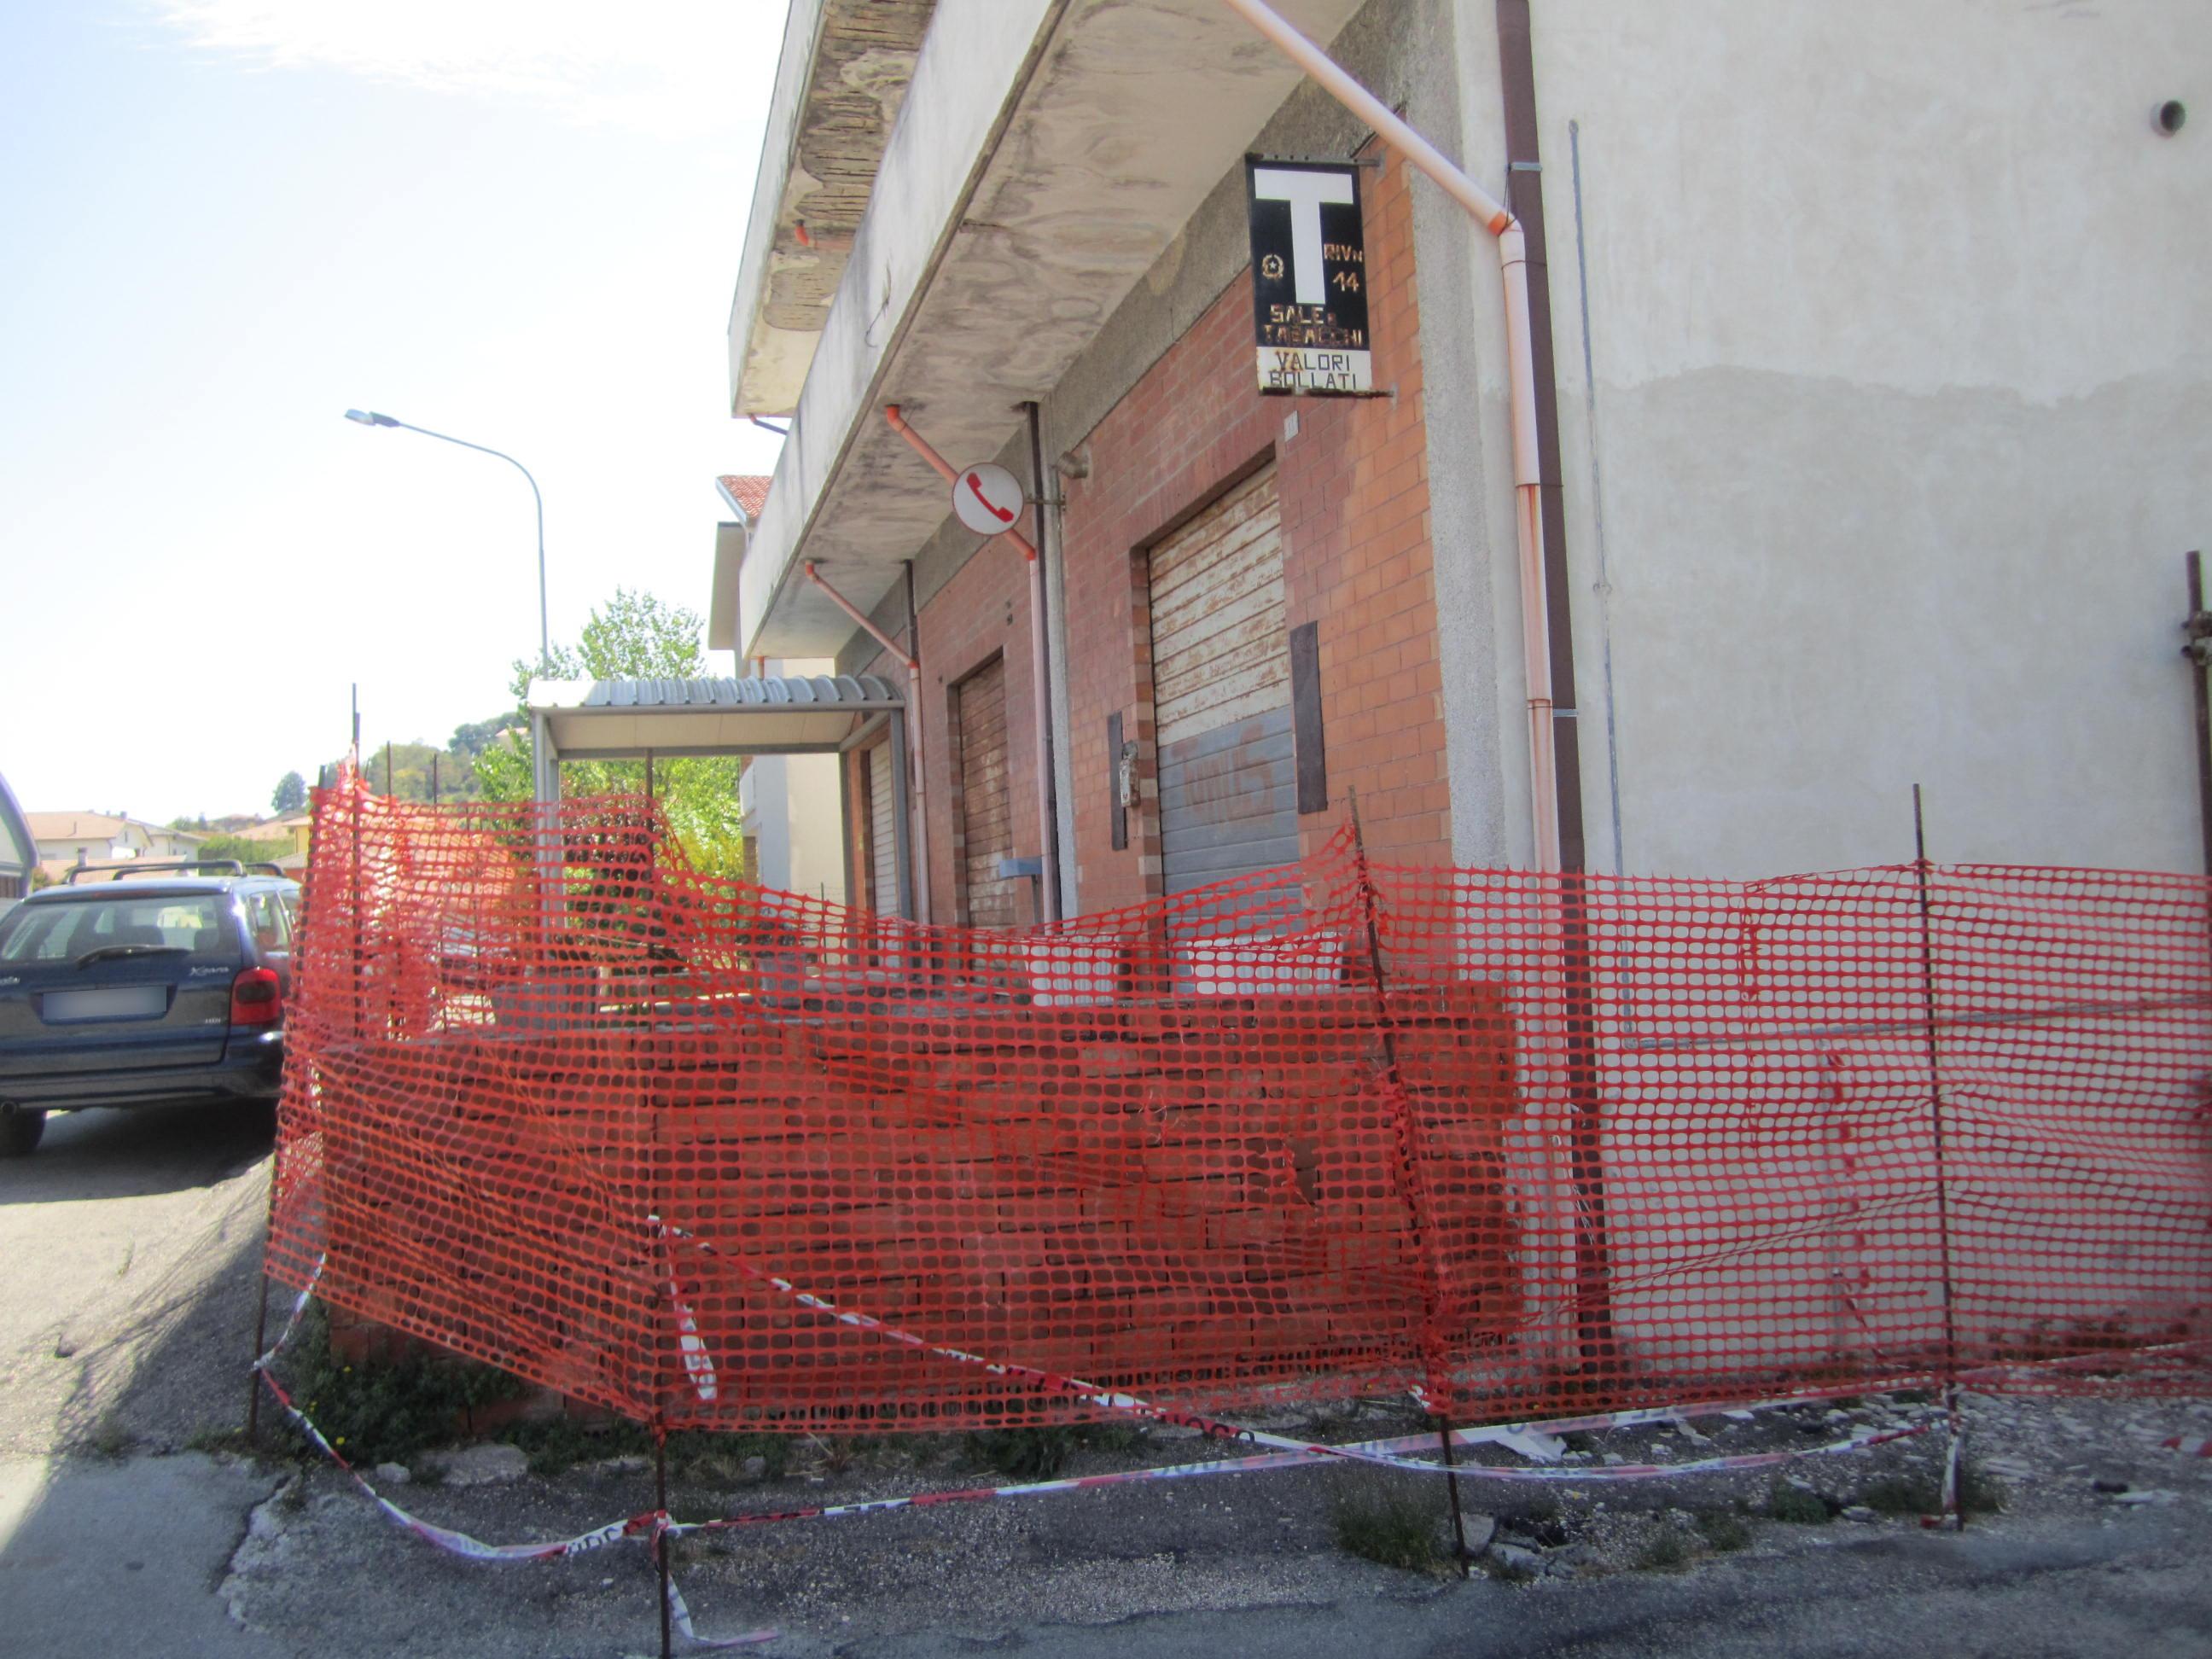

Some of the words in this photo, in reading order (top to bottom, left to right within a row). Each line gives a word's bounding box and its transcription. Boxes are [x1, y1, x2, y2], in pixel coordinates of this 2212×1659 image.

[1254, 168, 1353, 305] T
[1333, 271, 1359, 292] 14
[1270, 304, 1324, 324] SALE
[1275, 351, 1350, 371] VALORI
[1269, 370, 1356, 390] BOLLATI
